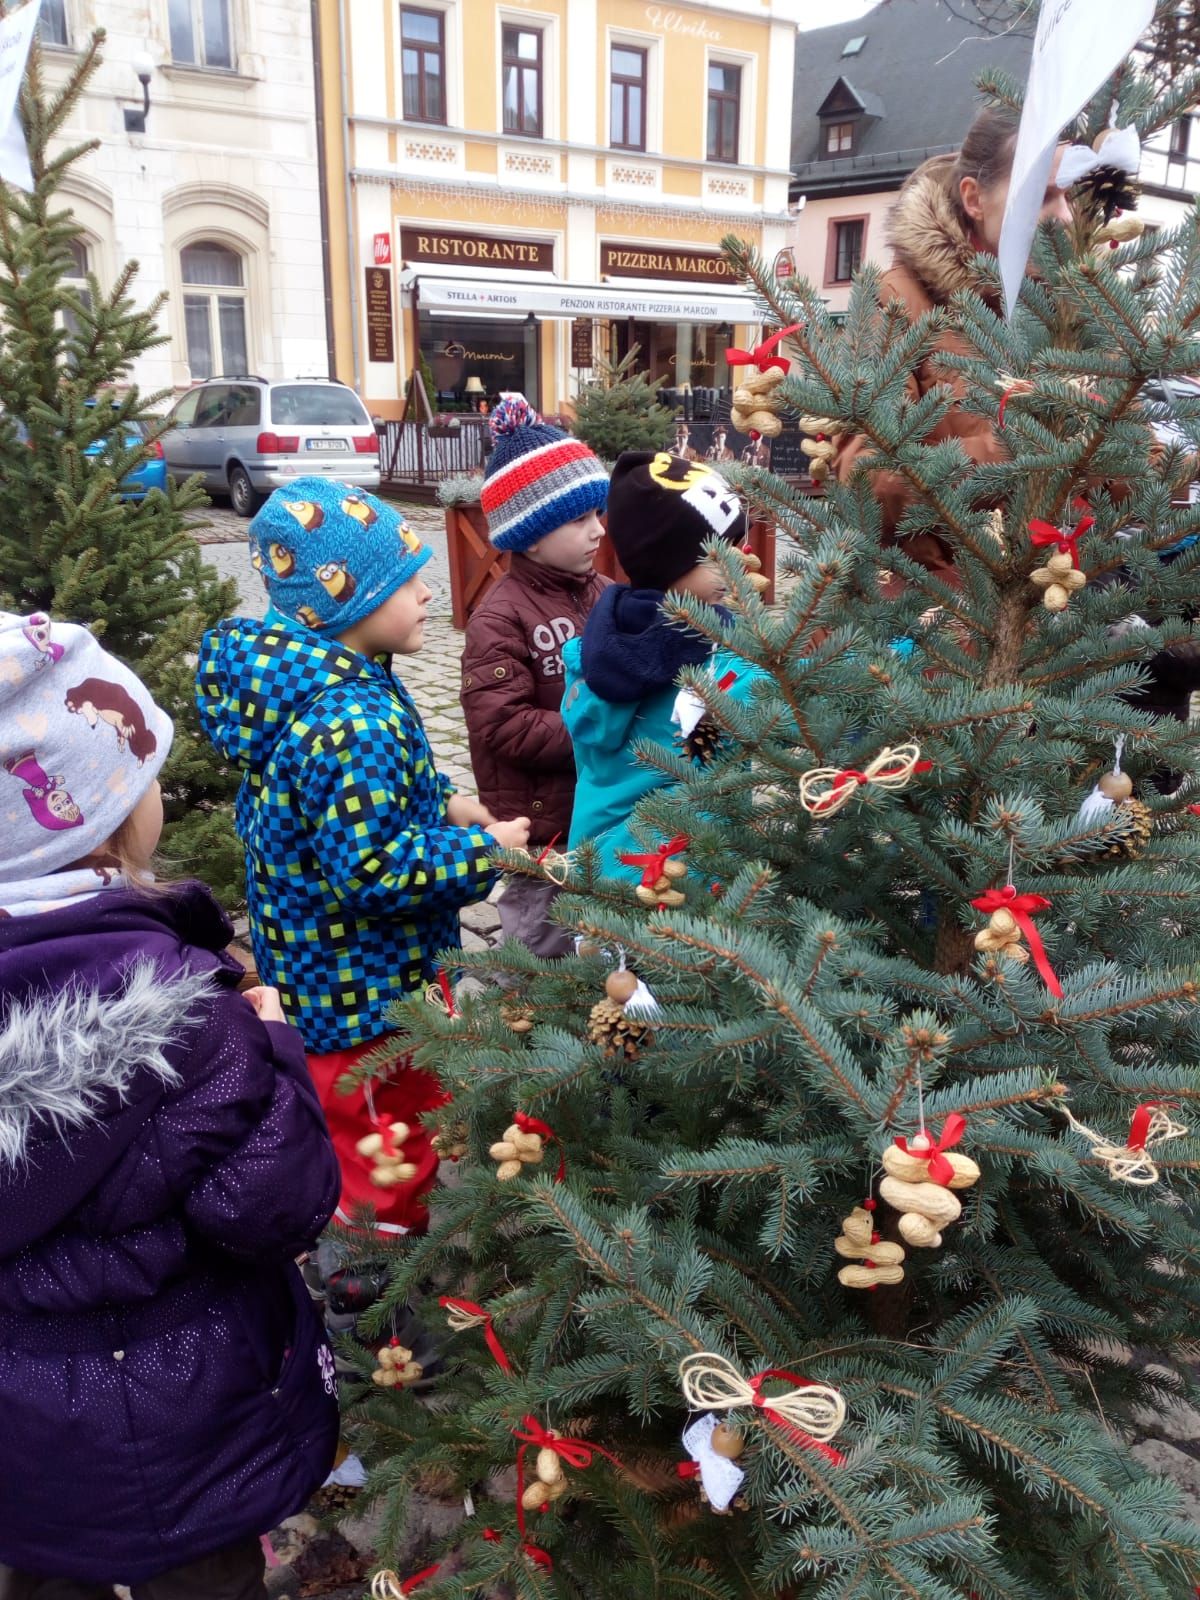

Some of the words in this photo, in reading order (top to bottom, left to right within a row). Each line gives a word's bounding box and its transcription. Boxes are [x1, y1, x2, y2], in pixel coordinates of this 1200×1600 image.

[375, 237, 390, 261] illy
[417, 235, 540, 263] RISTORANTE
[607, 250, 673, 272] PIZZERIA
[676, 256, 737, 277] MARCON
[447, 291, 477, 301] STELLA
[487, 294, 518, 304] ARTOIS
[560, 298, 595, 310] PENZION
[597, 300, 648, 313] RISTORANTE
[648, 303, 681, 315] PIZZERIA
[683, 306, 718, 316] MARCONI
[445, 343, 514, 362] Marconi
[529, 616, 576, 659] OD
